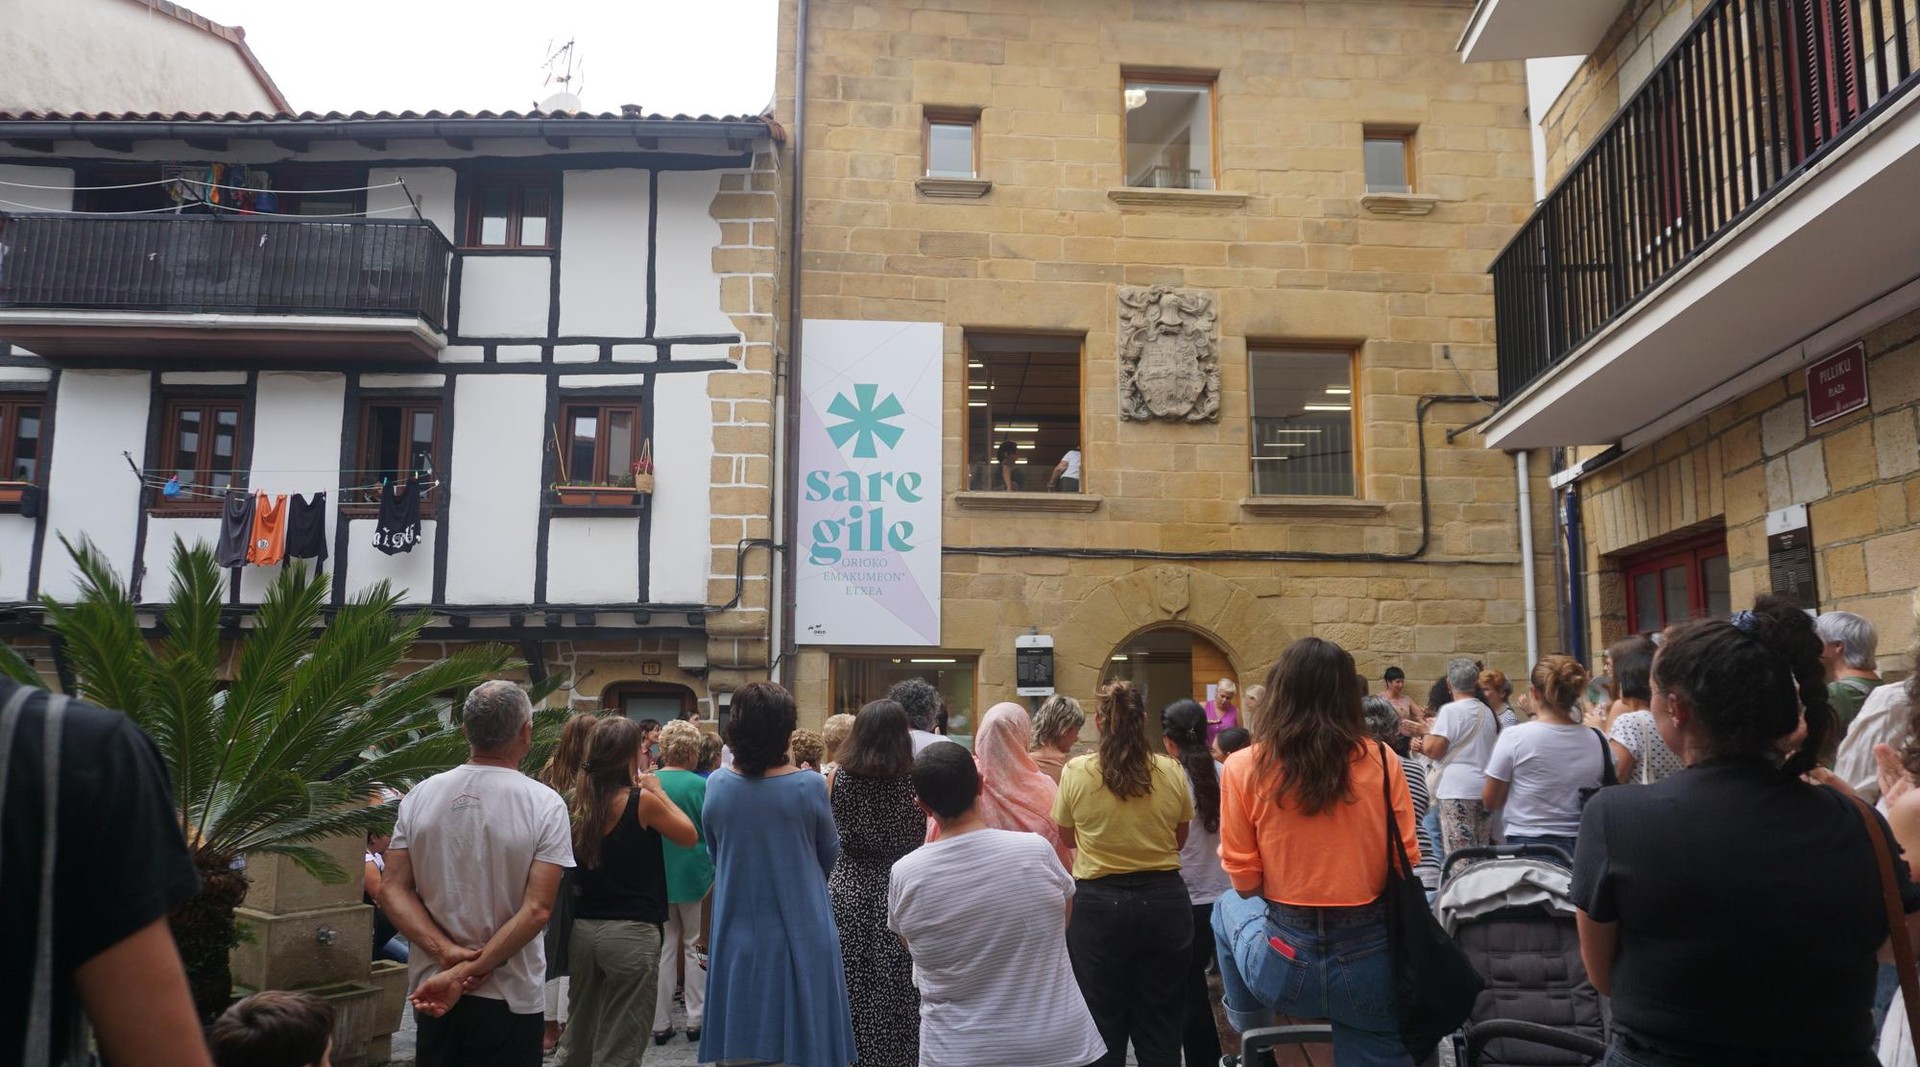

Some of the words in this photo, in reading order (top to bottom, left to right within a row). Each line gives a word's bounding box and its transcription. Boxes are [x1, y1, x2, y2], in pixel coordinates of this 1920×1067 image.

[1820, 358, 1851, 385] PILLIKU
[1828, 384, 1846, 398] PLAZA
[805, 469, 924, 503] sare
[808, 504, 916, 566] gile
[841, 557, 888, 568] ORIOKO
[845, 585, 883, 596] ETXEA
